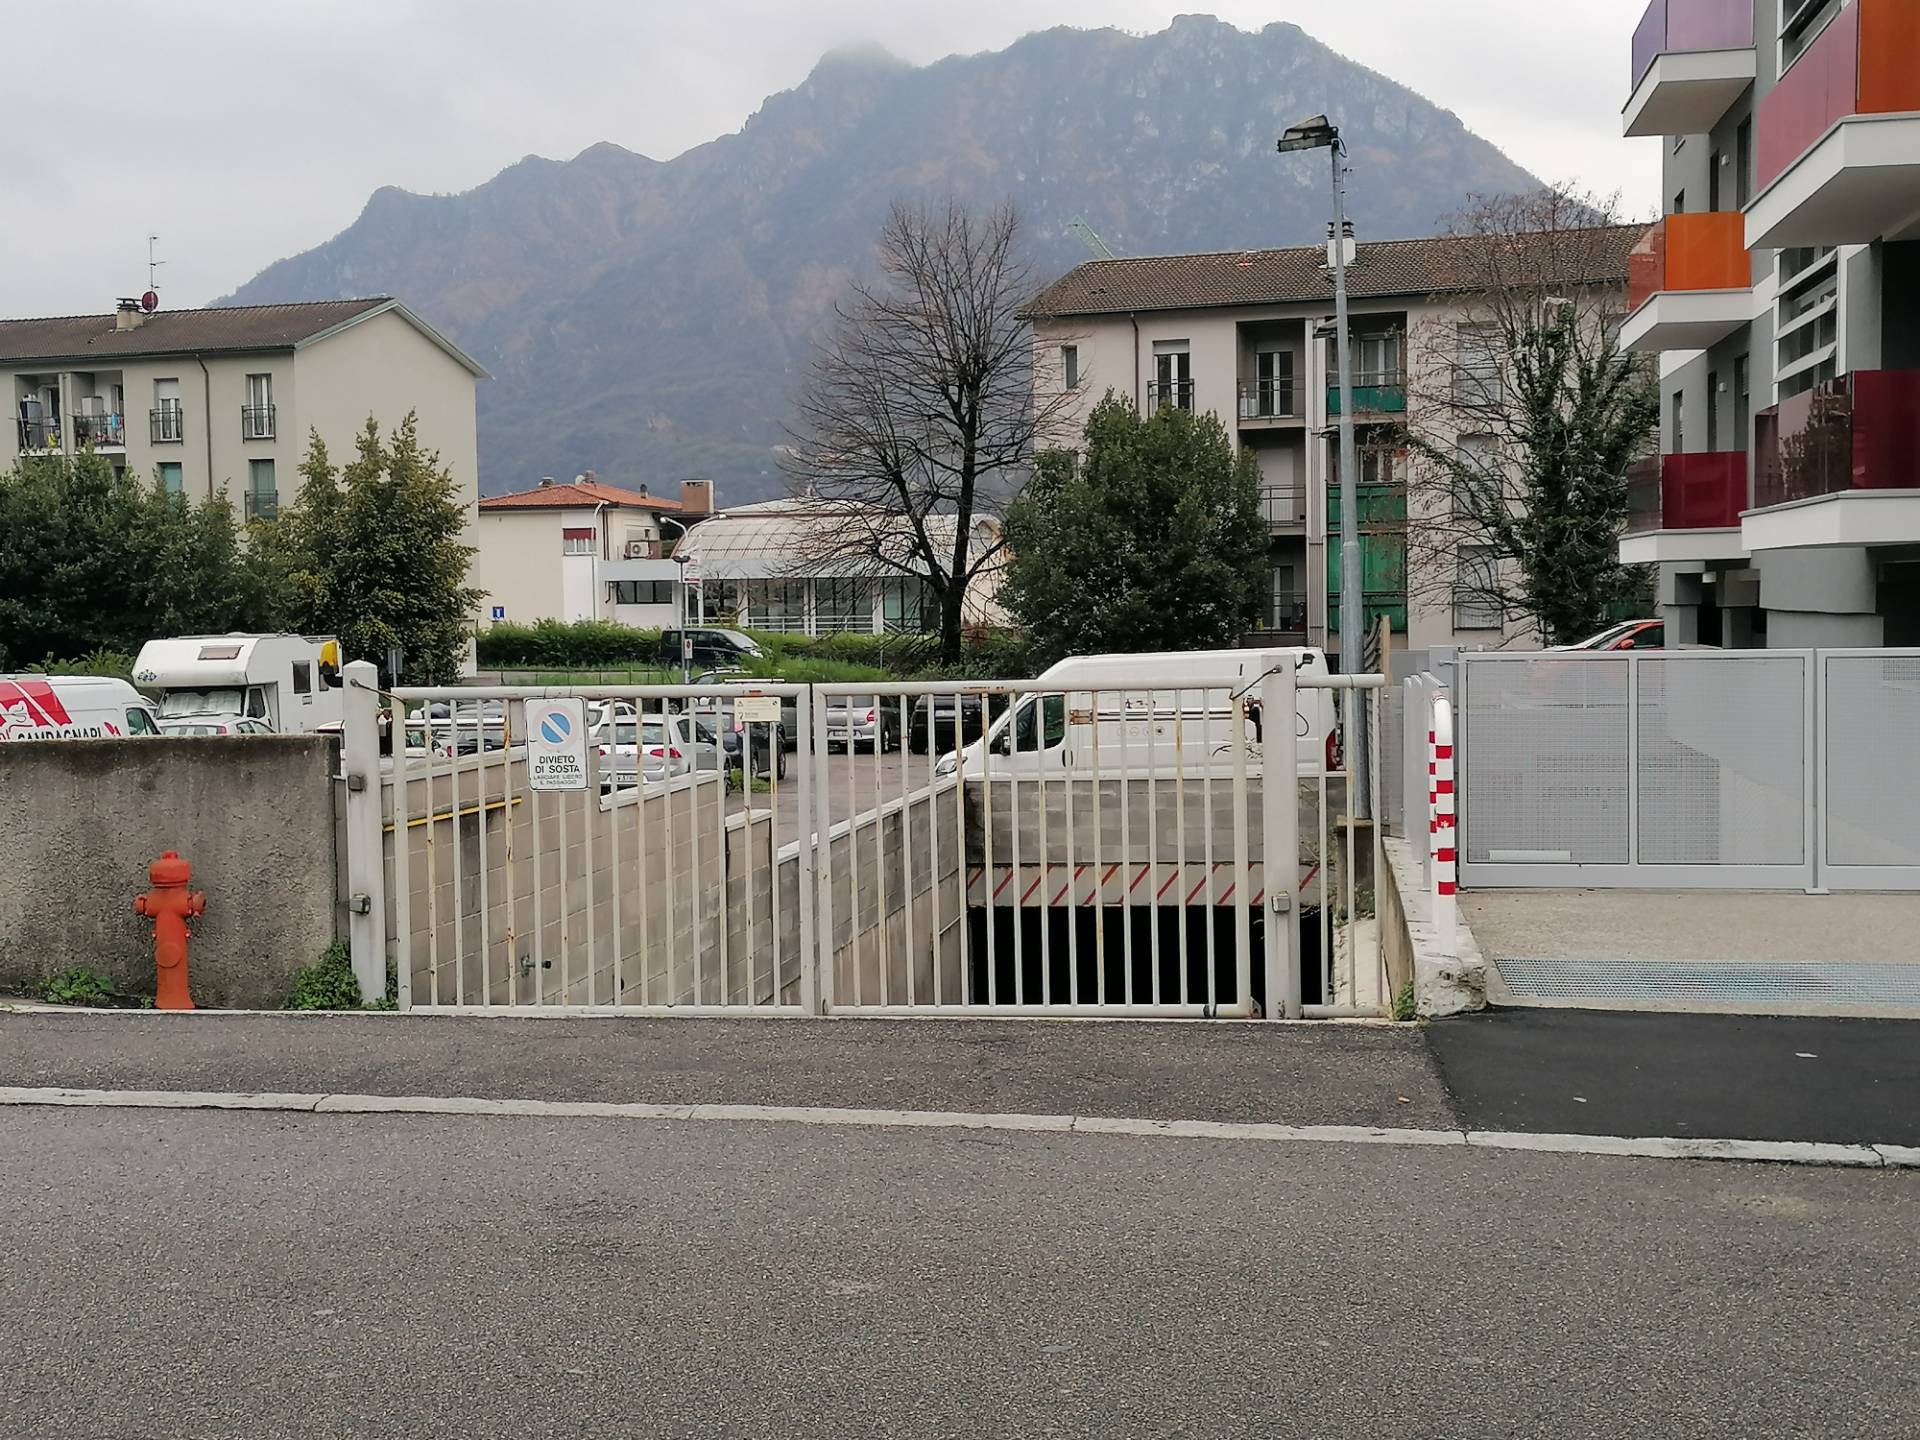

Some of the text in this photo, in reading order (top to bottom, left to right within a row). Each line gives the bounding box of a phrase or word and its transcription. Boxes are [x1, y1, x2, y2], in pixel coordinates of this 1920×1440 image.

[539, 755, 575, 764] DIVIETO
[535, 765, 580, 774] DI SOSTA
